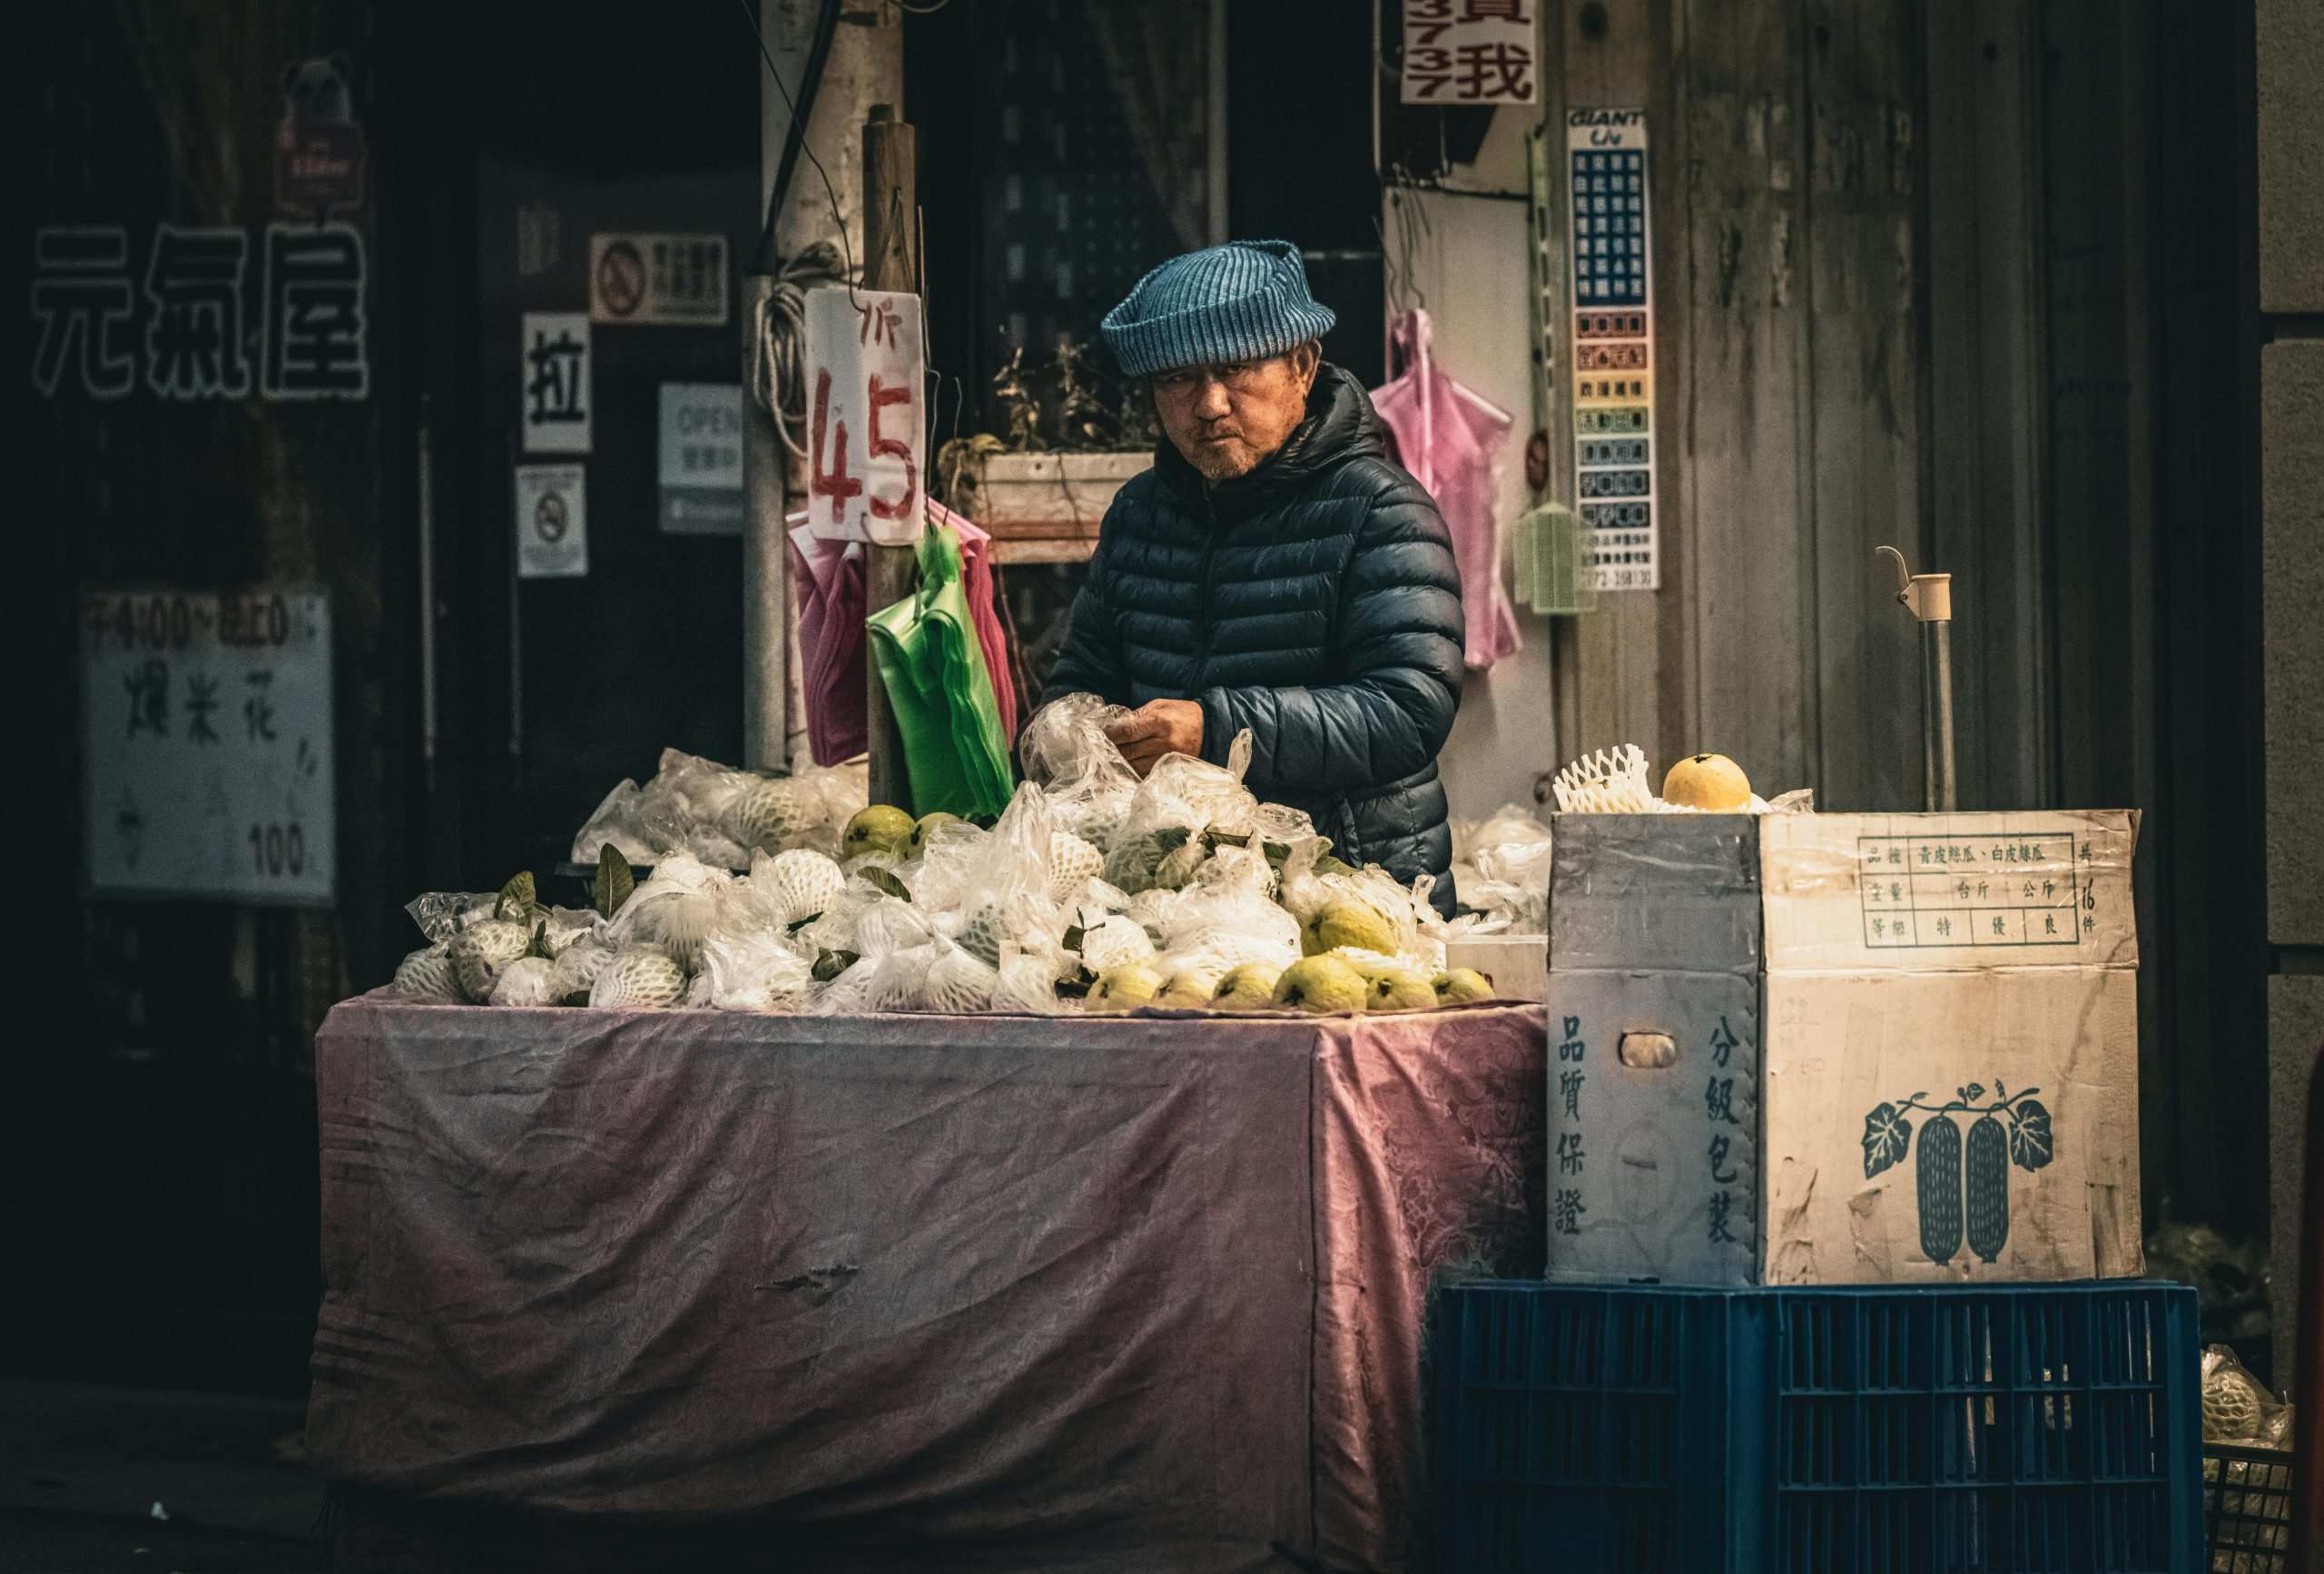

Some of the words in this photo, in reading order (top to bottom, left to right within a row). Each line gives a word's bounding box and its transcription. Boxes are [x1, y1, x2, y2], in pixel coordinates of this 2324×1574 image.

[1569, 110, 1644, 127] GIANT
[30, 220, 370, 402] 元氣屋
[529, 330, 586, 425] 拉
[811, 366, 918, 524] 45
[249, 821, 305, 877] 100
[1871, 917, 1905, 937] 等級
[1935, 915, 1952, 937] 特
[1991, 915, 2006, 937] 優
[2044, 913, 2058, 935] 良
[1554, 1016, 1587, 1237] 品質保證
[1704, 1014, 1740, 1245] 分級包裝
